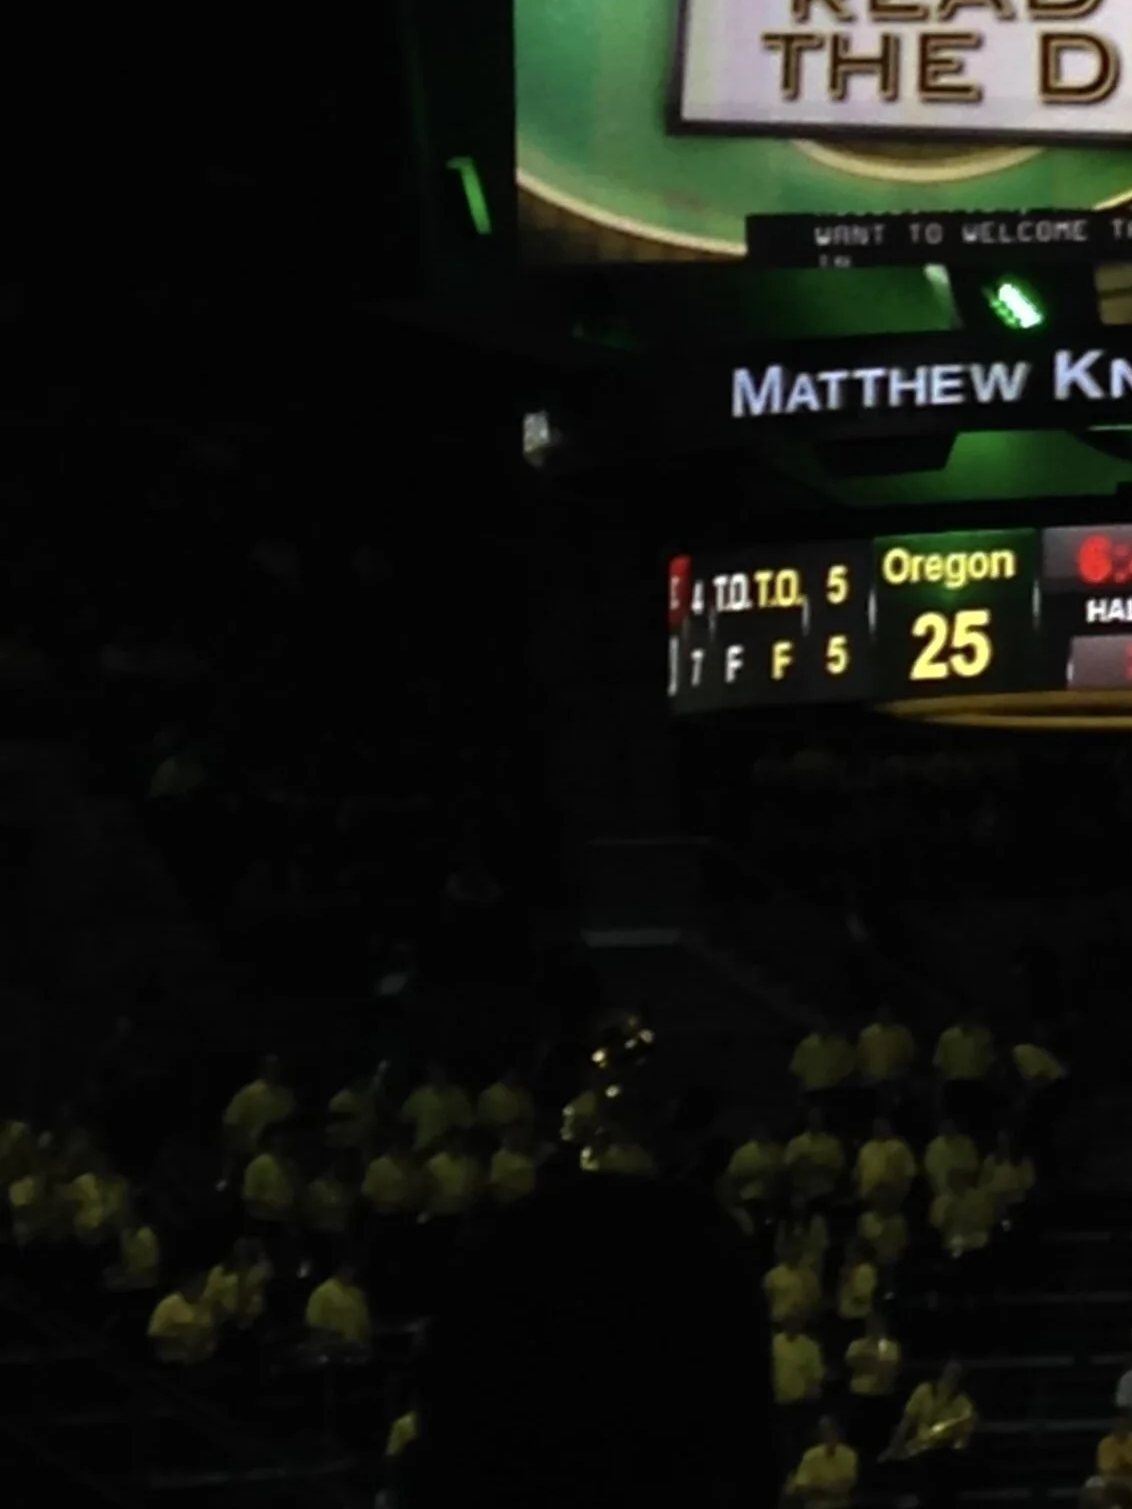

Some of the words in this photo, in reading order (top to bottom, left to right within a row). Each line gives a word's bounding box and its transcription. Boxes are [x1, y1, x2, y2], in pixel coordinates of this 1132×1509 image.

[761, 31, 983, 104] THE
[910, 222, 943, 245] TO
[962, 218, 1088, 244] WELCOME
[732, 363, 1028, 418] MATTHEW
[826, 565, 848, 604] 5
[882, 546, 1016, 588] Oregon
[724, 644, 745, 683] F
[771, 640, 794, 680] F
[826, 635, 849, 675] 5
[909, 608, 992, 681] 25
